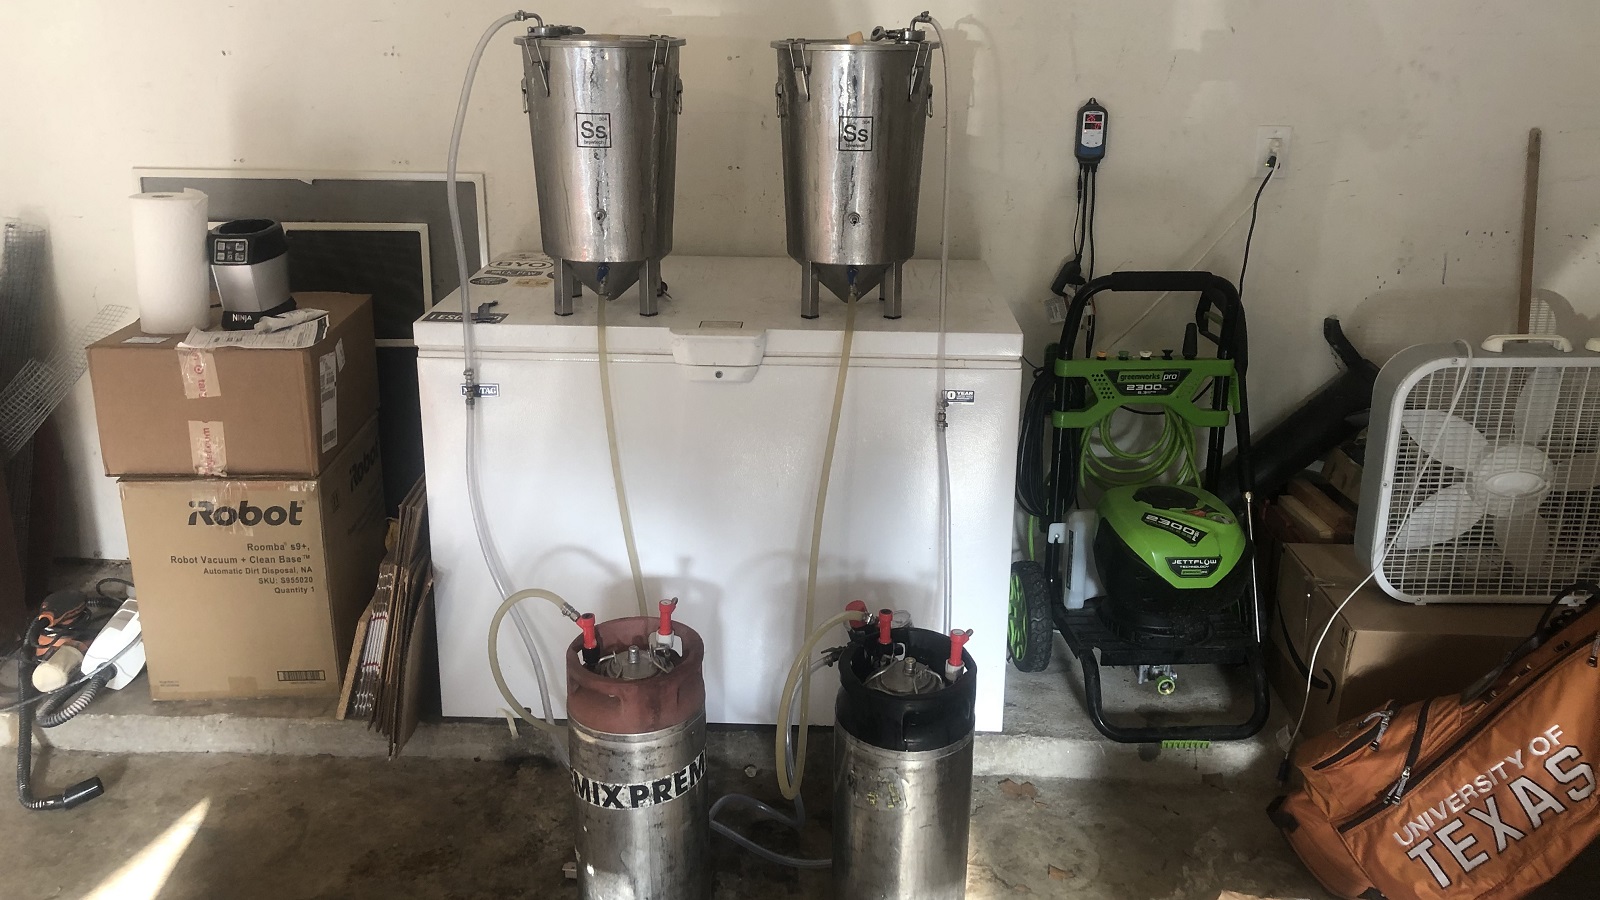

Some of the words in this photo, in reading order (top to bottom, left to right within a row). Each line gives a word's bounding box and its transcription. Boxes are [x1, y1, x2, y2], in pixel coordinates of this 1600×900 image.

[581, 120, 607, 139] Ss
[843, 124, 869, 142] Ss
[232, 313, 252, 322] NINJA
[1120, 372, 1160, 381] greenworks
[1163, 373, 1178, 381] pro
[1126, 383, 1162, 391] 2300
[1145, 514, 1196, 536] 2300
[170, 555, 198, 564] Robot
[200, 556, 238, 564] Vacuum
[249, 555, 276, 564] Clean
[203, 567, 243, 575] Automatic
[245, 567, 260, 575] Dirt
[262, 567, 299, 575] Disposal,
[280, 576, 313, 584] S955020
[1392, 748, 1525, 847] UNIVERSITY
[1527, 724, 1564, 757] OF
[1406, 745, 1597, 889] TEXAS
